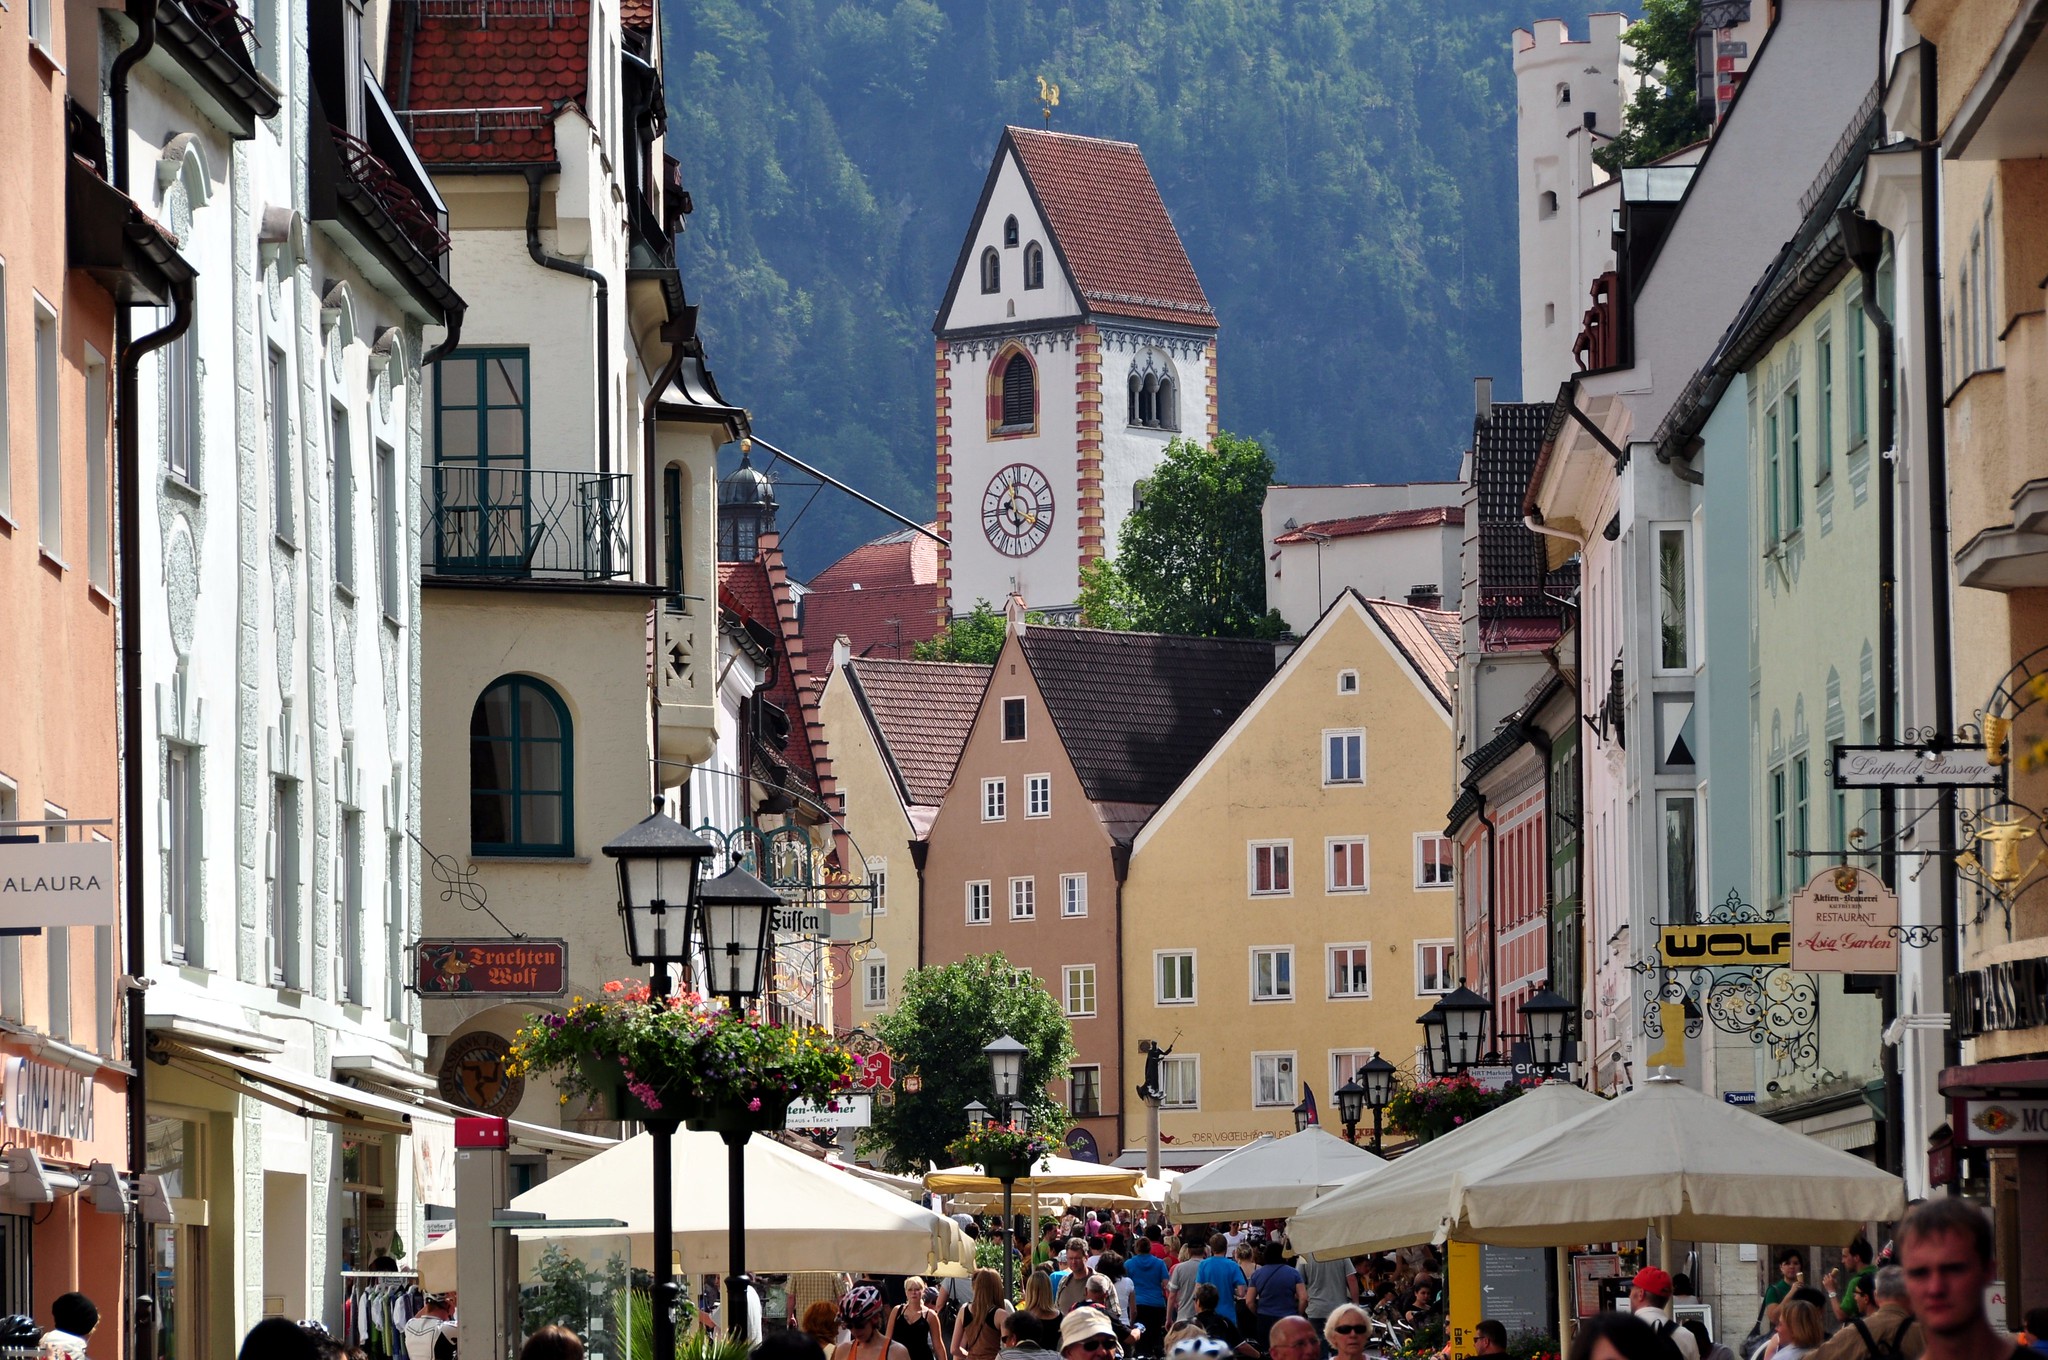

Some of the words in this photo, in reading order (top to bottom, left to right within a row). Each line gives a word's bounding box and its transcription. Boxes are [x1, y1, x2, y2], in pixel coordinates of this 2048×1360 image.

[1849, 755, 1923, 780] Luitpold
[1923, 756, 1991, 781] Passage
[3, 875, 101, 893] ALAURA
[1816, 912, 1877, 922] RESTAURANT
[1665, 932, 1790, 957] WOLF
[1798, 931, 1839, 952] Asia
[1840, 932, 1891, 949] Garten
[469, 947, 556, 967] Trachten
[488, 967, 538, 989] Wolf
[1192, 1132, 1215, 1144] DER
